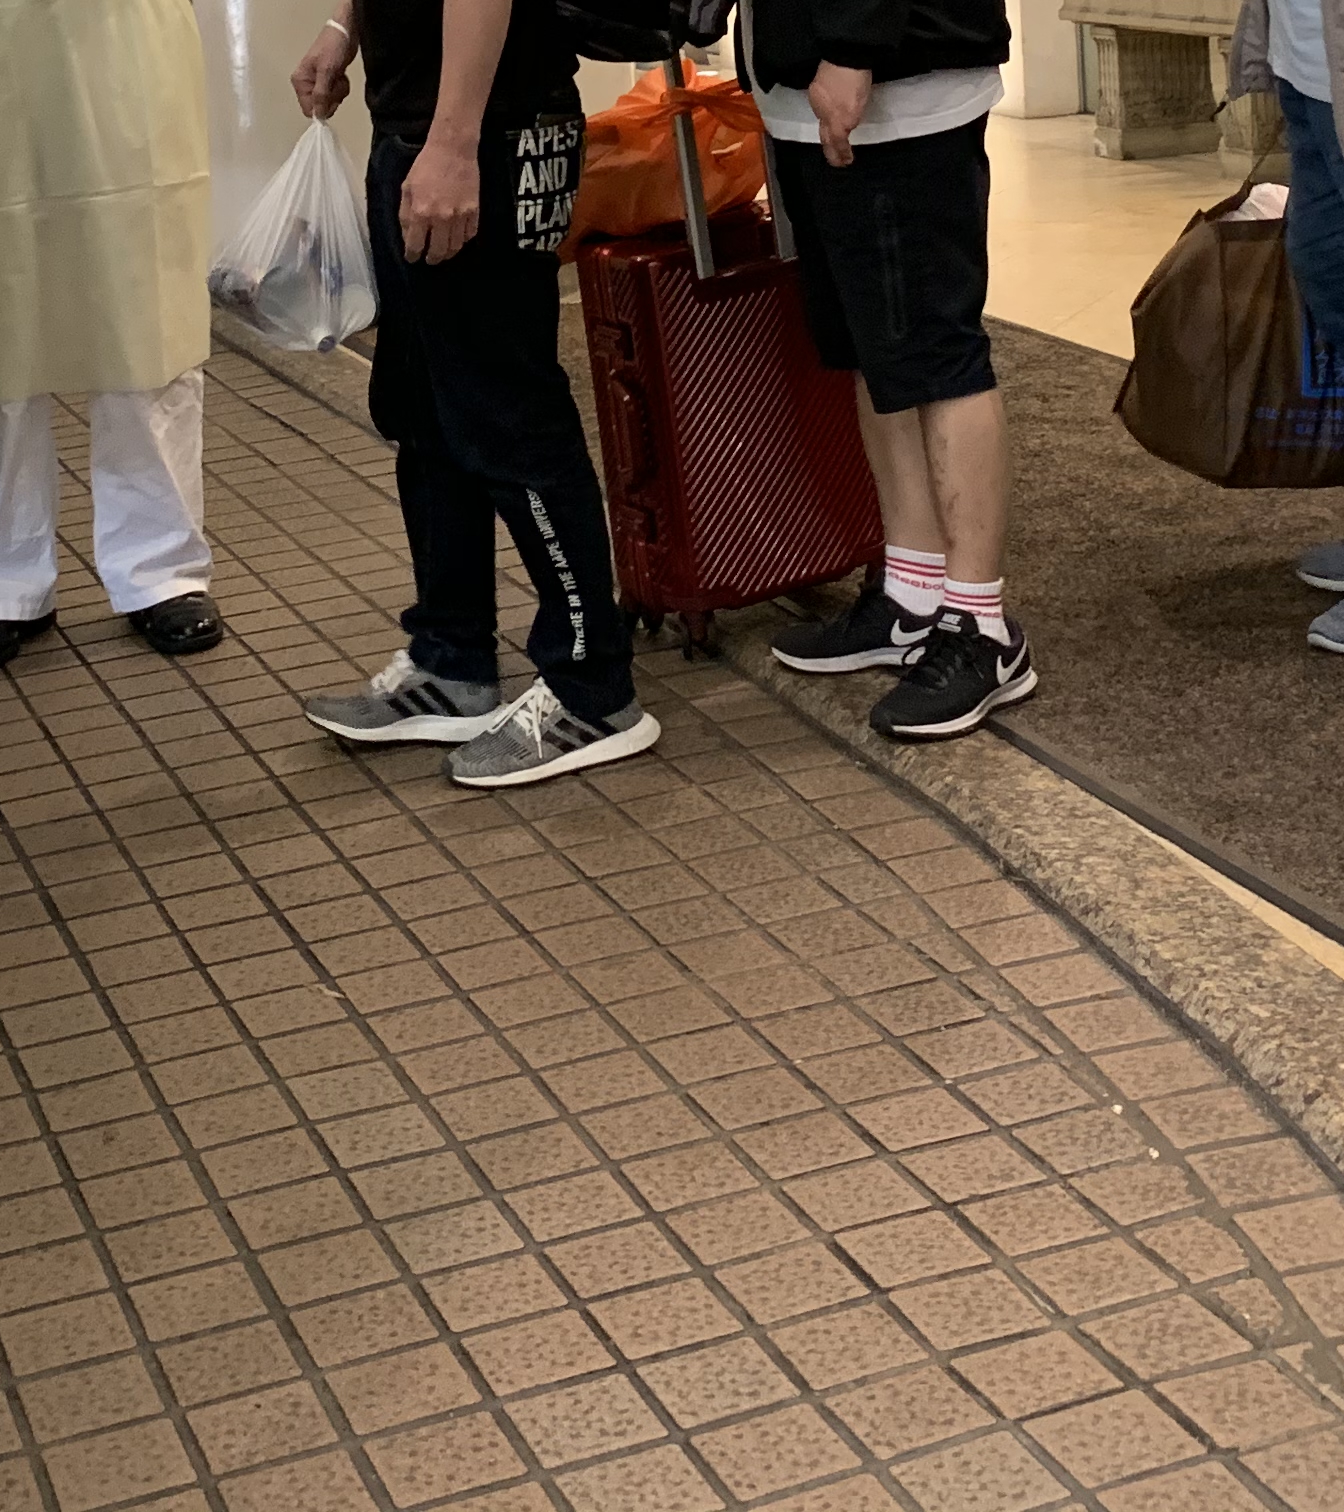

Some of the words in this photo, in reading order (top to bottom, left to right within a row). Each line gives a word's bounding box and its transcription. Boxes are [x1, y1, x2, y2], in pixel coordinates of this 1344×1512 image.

[516, 120, 579, 157] APES
[517, 157, 569, 196] AND
[545, 540, 570, 569] AAPE
[557, 570, 578, 593] THE
[567, 594, 582, 607] IN
